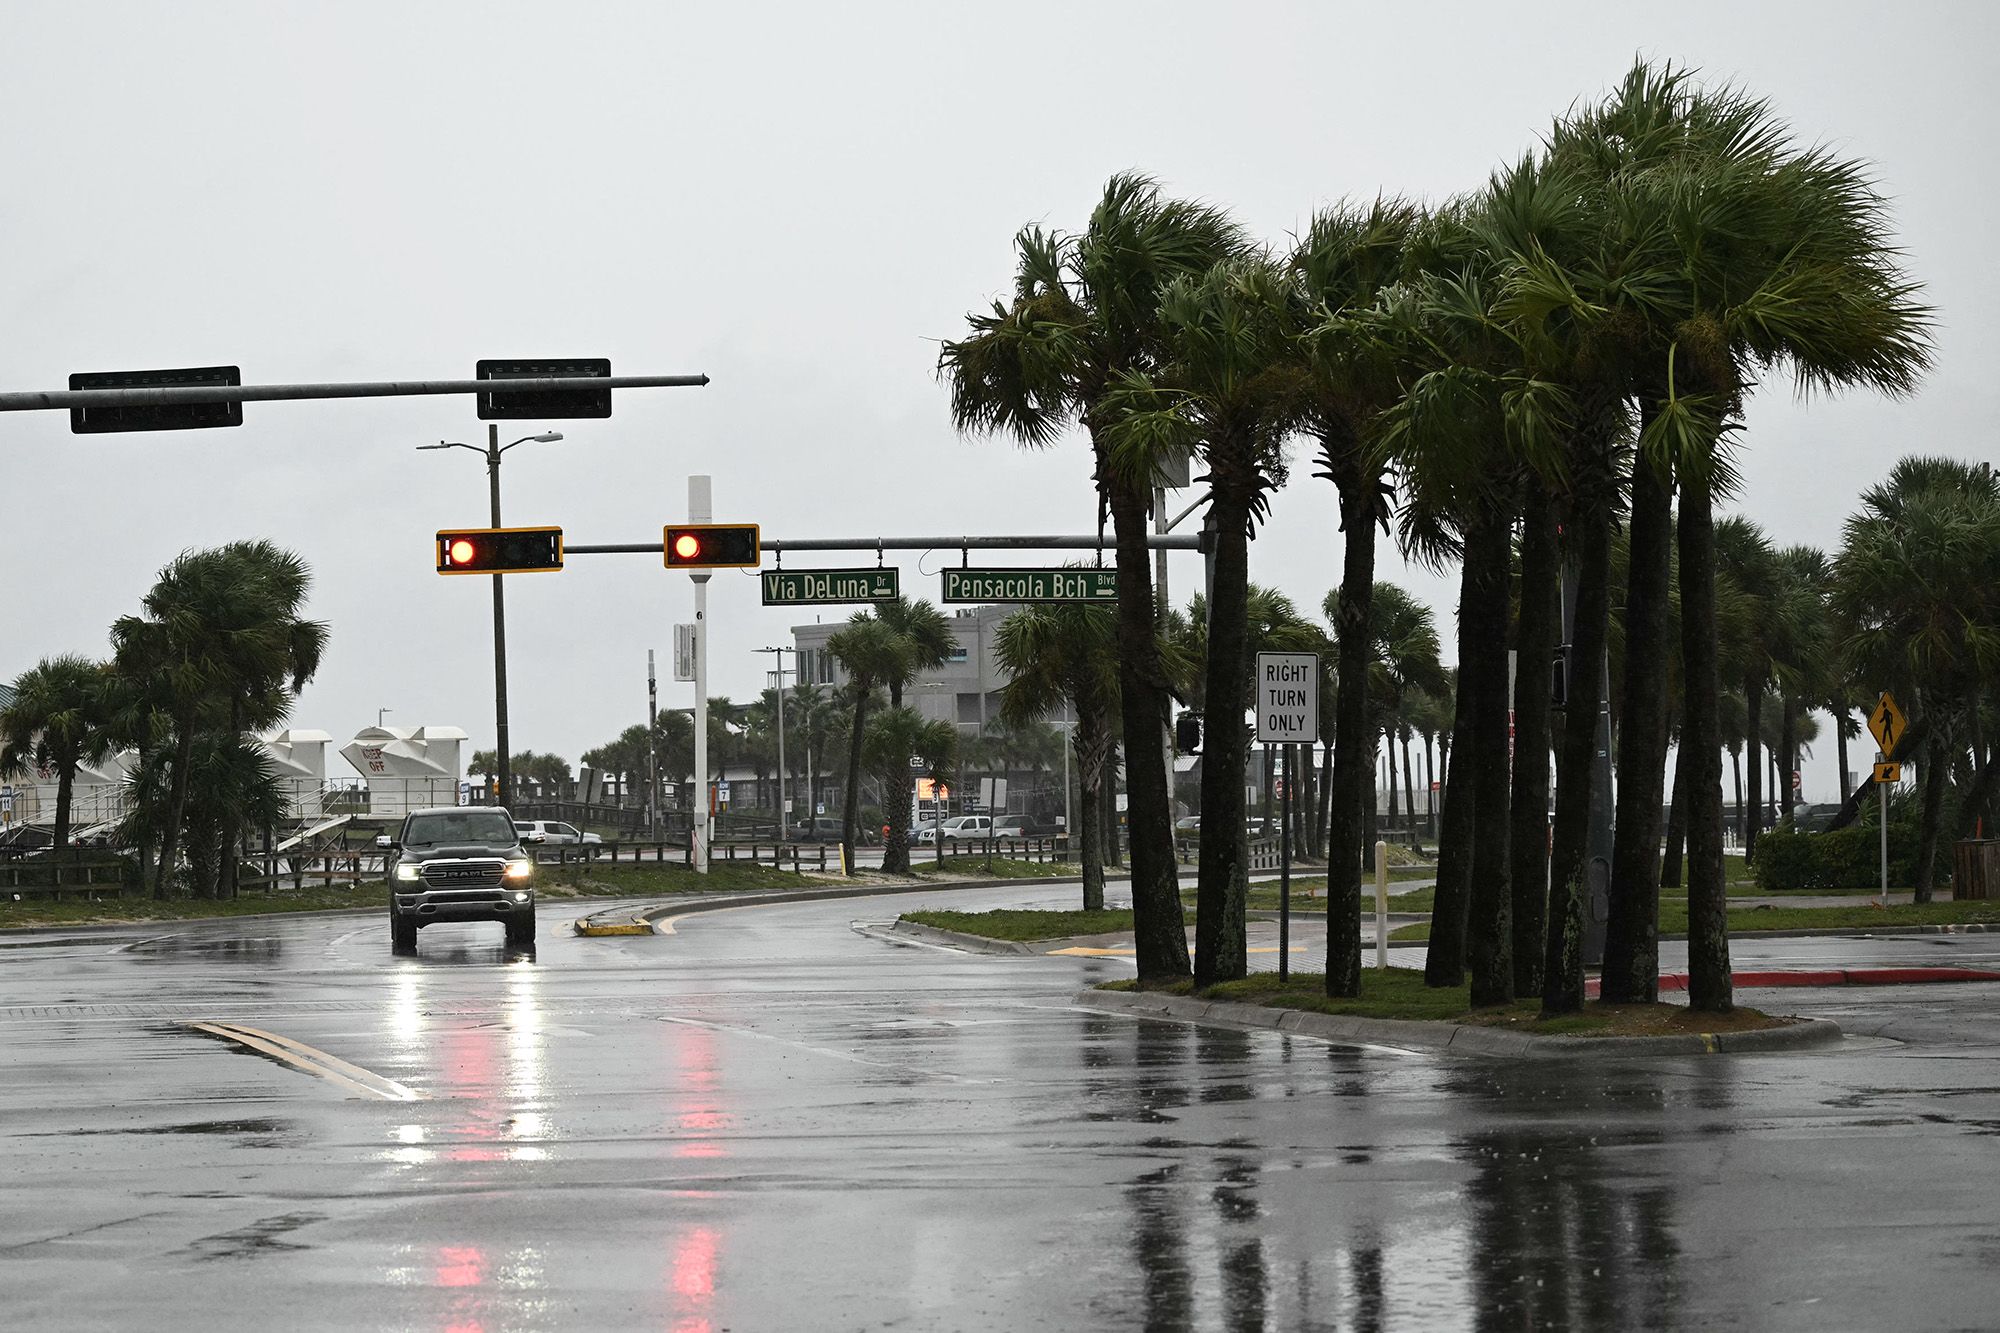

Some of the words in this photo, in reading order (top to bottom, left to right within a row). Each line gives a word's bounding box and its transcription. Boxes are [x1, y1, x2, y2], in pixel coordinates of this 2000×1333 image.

[768, 575, 796, 599] Via
[804, 574, 869, 599] DeLuna
[876, 575, 886, 587] Dr
[949, 573, 1044, 598] Pensacola
[1053, 573, 1087, 598] Bch
[1097, 574, 1116, 586] Blvd
[1266, 664, 1309, 682] RIGHT
[1269, 689, 1306, 707] TURN
[1269, 714, 1306, 732] ONLY
[361, 748, 382, 760] KEEP
[369, 761, 385, 772] OFF
[461, 794, 467, 804] 9
[721, 791, 727, 800] 7
[3, 798, 10, 809] 11
[448, 870, 482, 878] RAM
